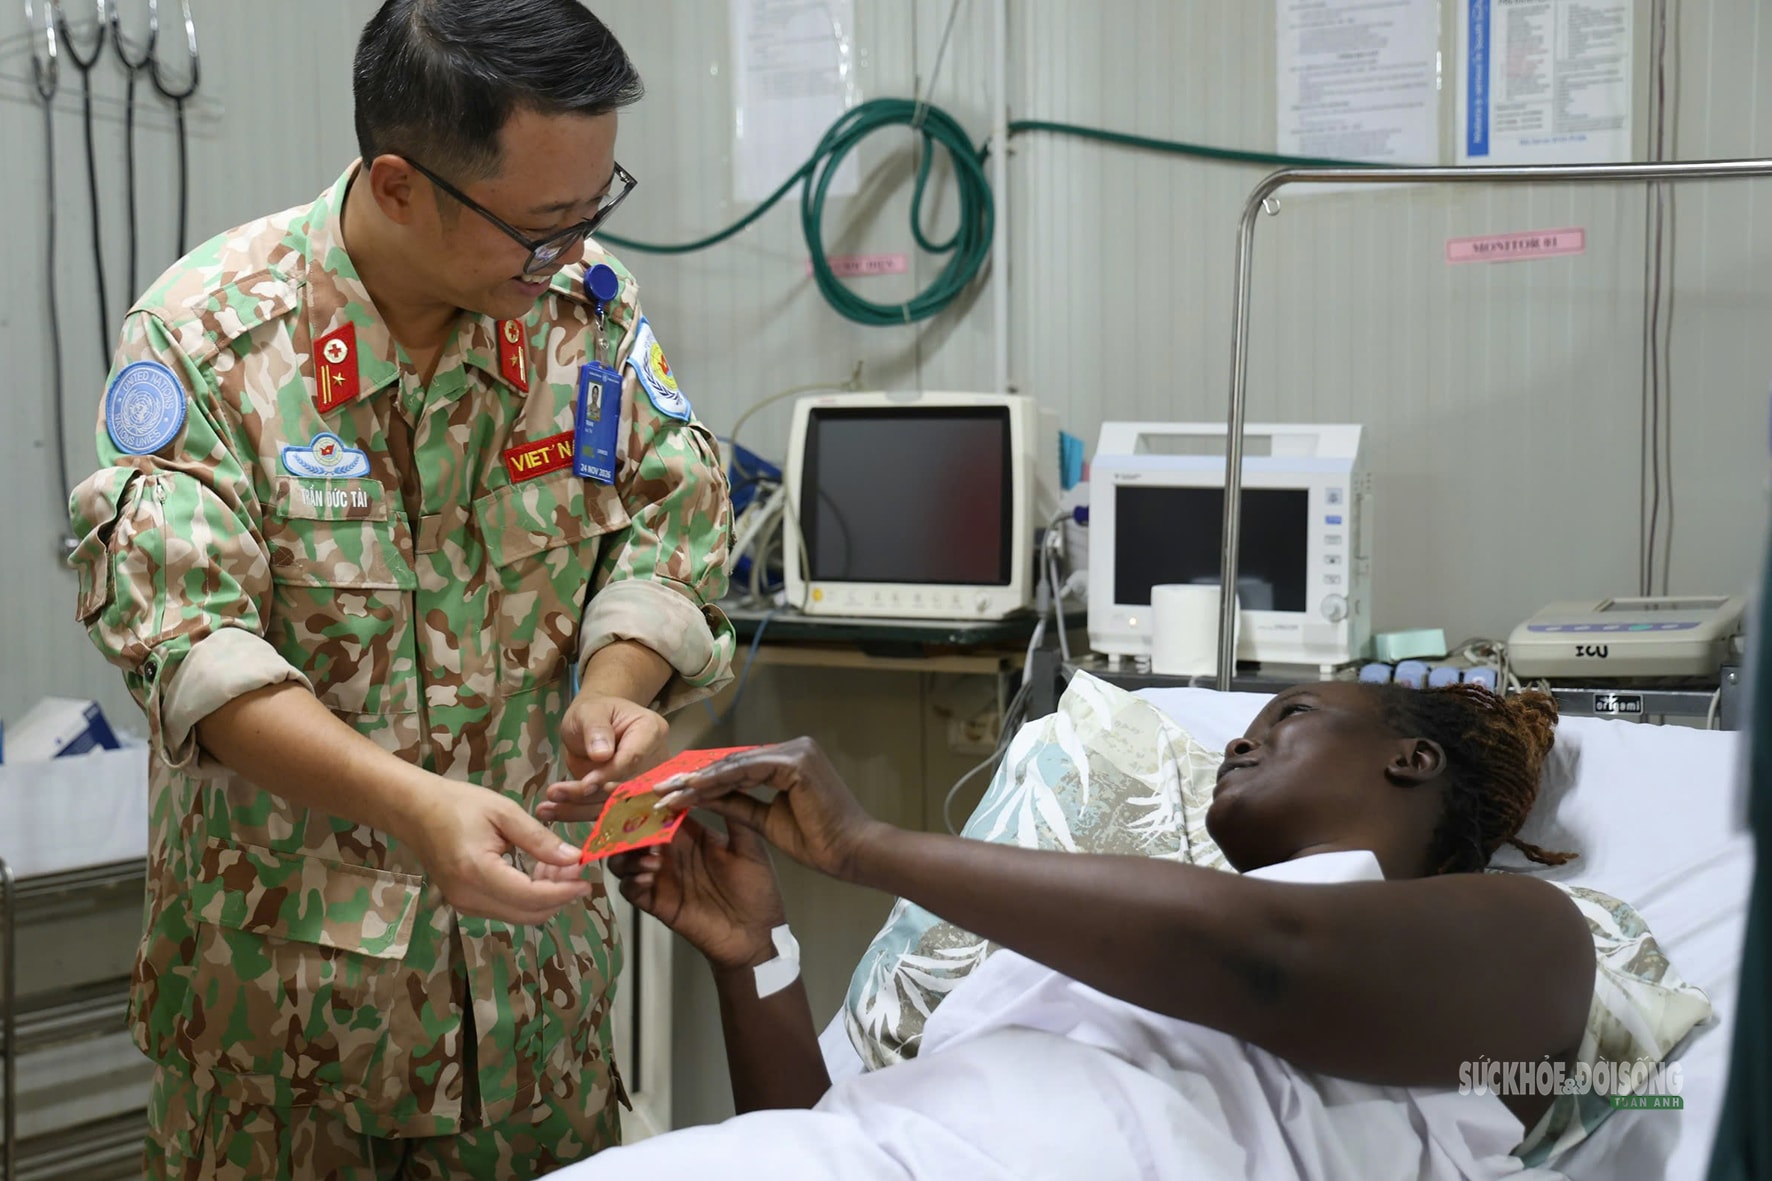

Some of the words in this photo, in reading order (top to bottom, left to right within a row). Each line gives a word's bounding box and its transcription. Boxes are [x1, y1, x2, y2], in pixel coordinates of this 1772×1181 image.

[1472, 237, 1541, 253] MONITOR
[122, 371, 149, 392] UNITED
[152, 372, 174, 410] NATIONS
[113, 413, 135, 446] NATIONS
[136, 429, 161, 447] UNIES
[1575, 645, 1608, 659] ICU
